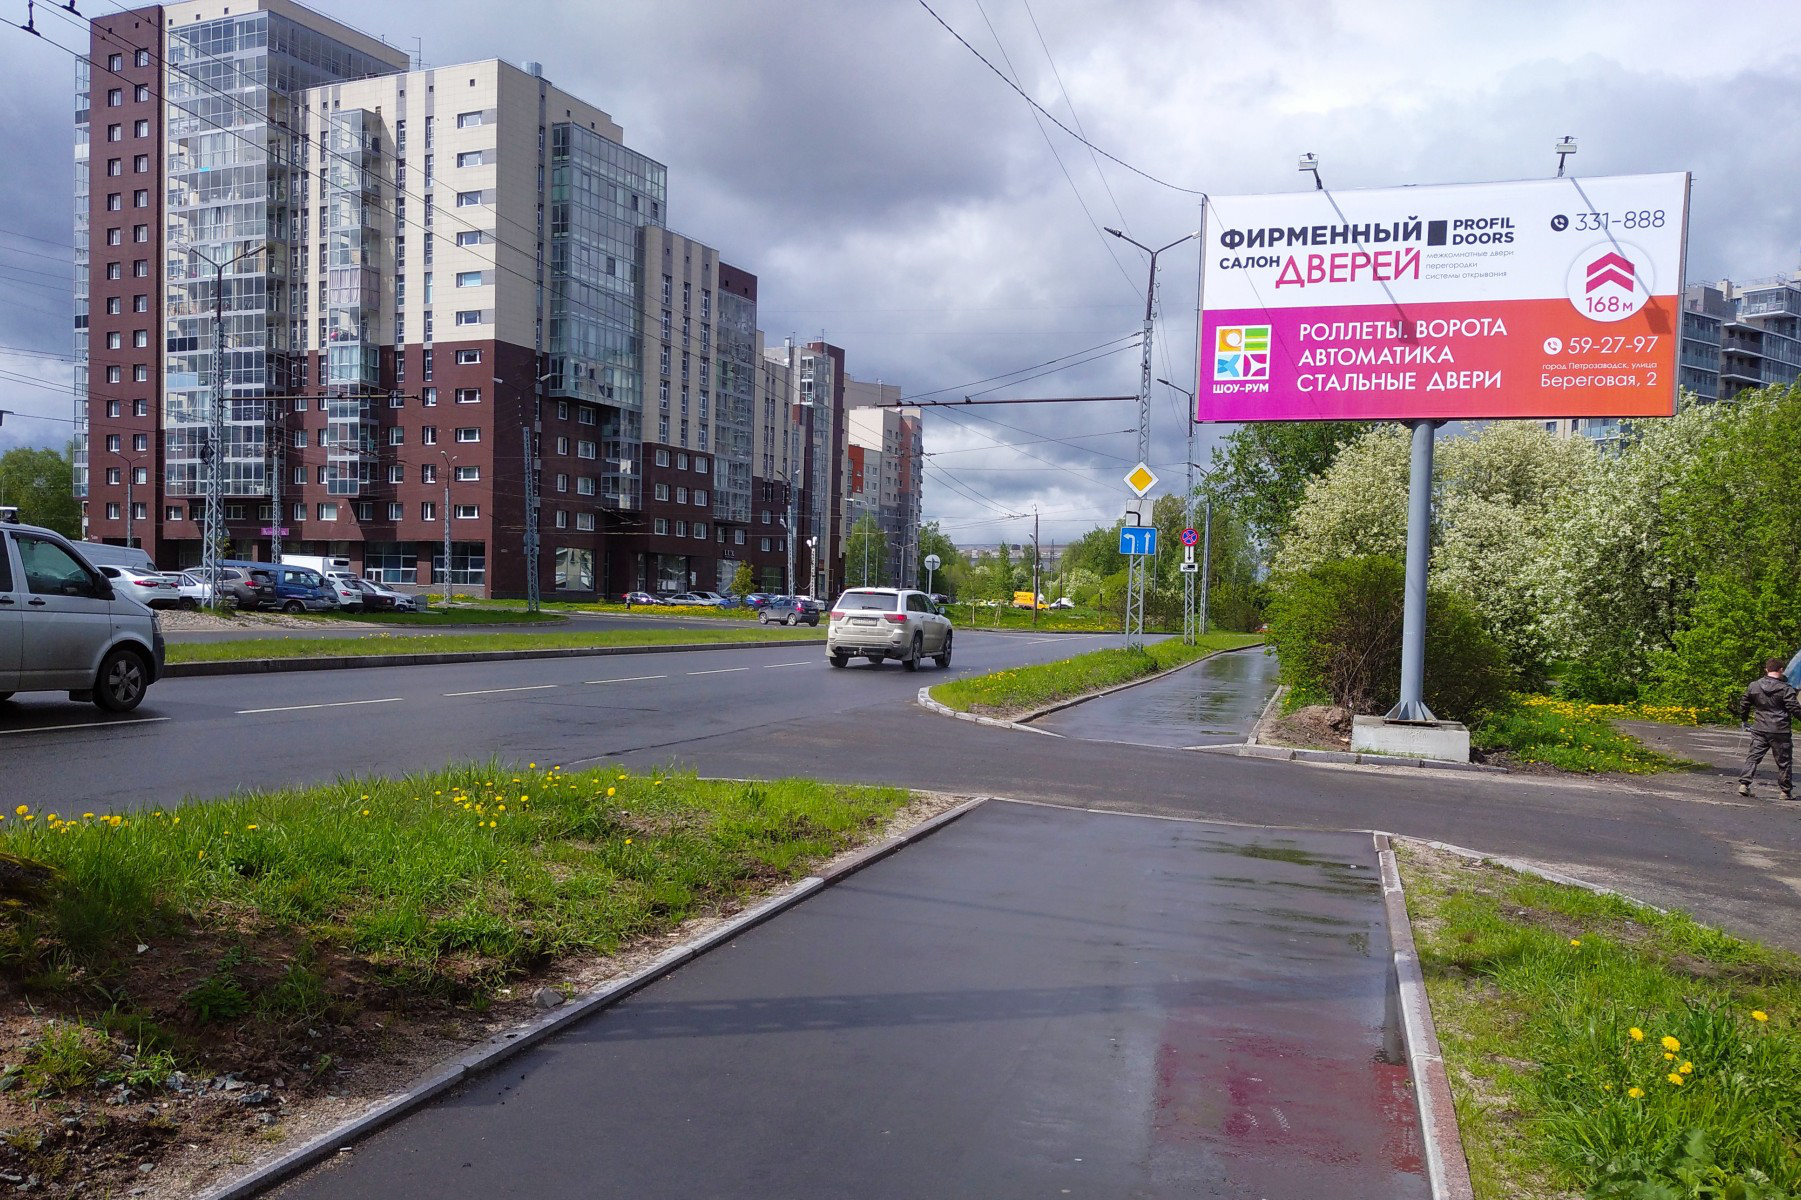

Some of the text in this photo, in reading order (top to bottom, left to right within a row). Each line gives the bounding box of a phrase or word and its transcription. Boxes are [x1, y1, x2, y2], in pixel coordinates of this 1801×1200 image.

[1453, 217, 1515, 231] PROFIL
[1575, 209, 1665, 231] 331-888
[1220, 216, 1422, 250] ФИРМЕННЫЙ
[1452, 231, 1515, 246] DOORS
[1219, 256, 1281, 270] САЛОН
[1426, 251, 1488, 259] межкомнатные
[1275, 248, 1420, 288] ДВЕРЕЙ
[1586, 296, 1618, 312] 168
[1415, 317, 1508, 339] ВОРОТА
[1568, 336, 1659, 354] 59-27-97
[1298, 345, 1455, 367] АВТОМАТИКА
[1542, 363, 1567, 371] город
[1212, 383, 1269, 394] ШОУ-РУМ
[1297, 370, 1502, 392] СТАЛЬНЫЕ ДВЕРИ
[1541, 372, 1657, 390] Береговая, 2
